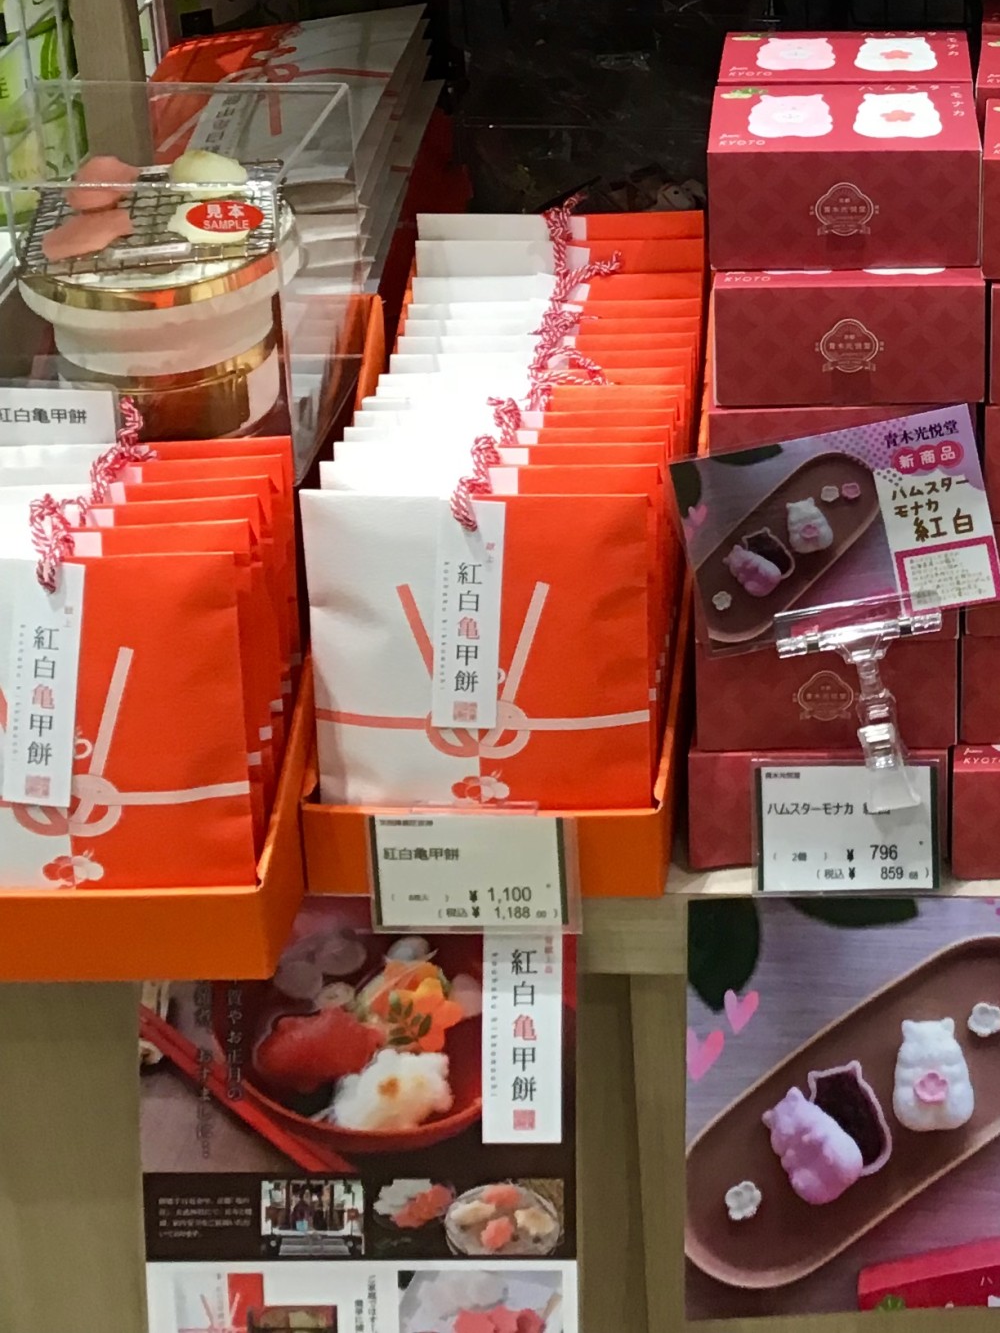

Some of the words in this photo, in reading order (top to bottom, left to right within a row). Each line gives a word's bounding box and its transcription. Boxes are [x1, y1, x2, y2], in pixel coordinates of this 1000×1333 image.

[206, 204, 245, 219] 見本
[203, 219, 250, 230] SAMPLE
[883, 420, 959, 449] 青木光悦堂
[898, 445, 956, 469] 新商品
[892, 477, 969, 500] ハムスター
[894, 499, 939, 517] モナカ
[914, 508, 974, 542] 紅白
[453, 562, 483, 693] 紅白亀甲餅
[27, 625, 60, 766] 紅白亀甲餅
[767, 802, 853, 815] ハムスターモナカ
[383, 847, 460, 861] 紅白亀甲餅
[869, 844, 898, 860] 796
[880, 867, 904, 880] 859
[487, 886, 532, 904] 1,100
[494, 906, 531, 921] 1,188
[511, 949, 538, 1101] 紅白亀甲餅
[226, 978, 244, 1101] 賀やお正月の
